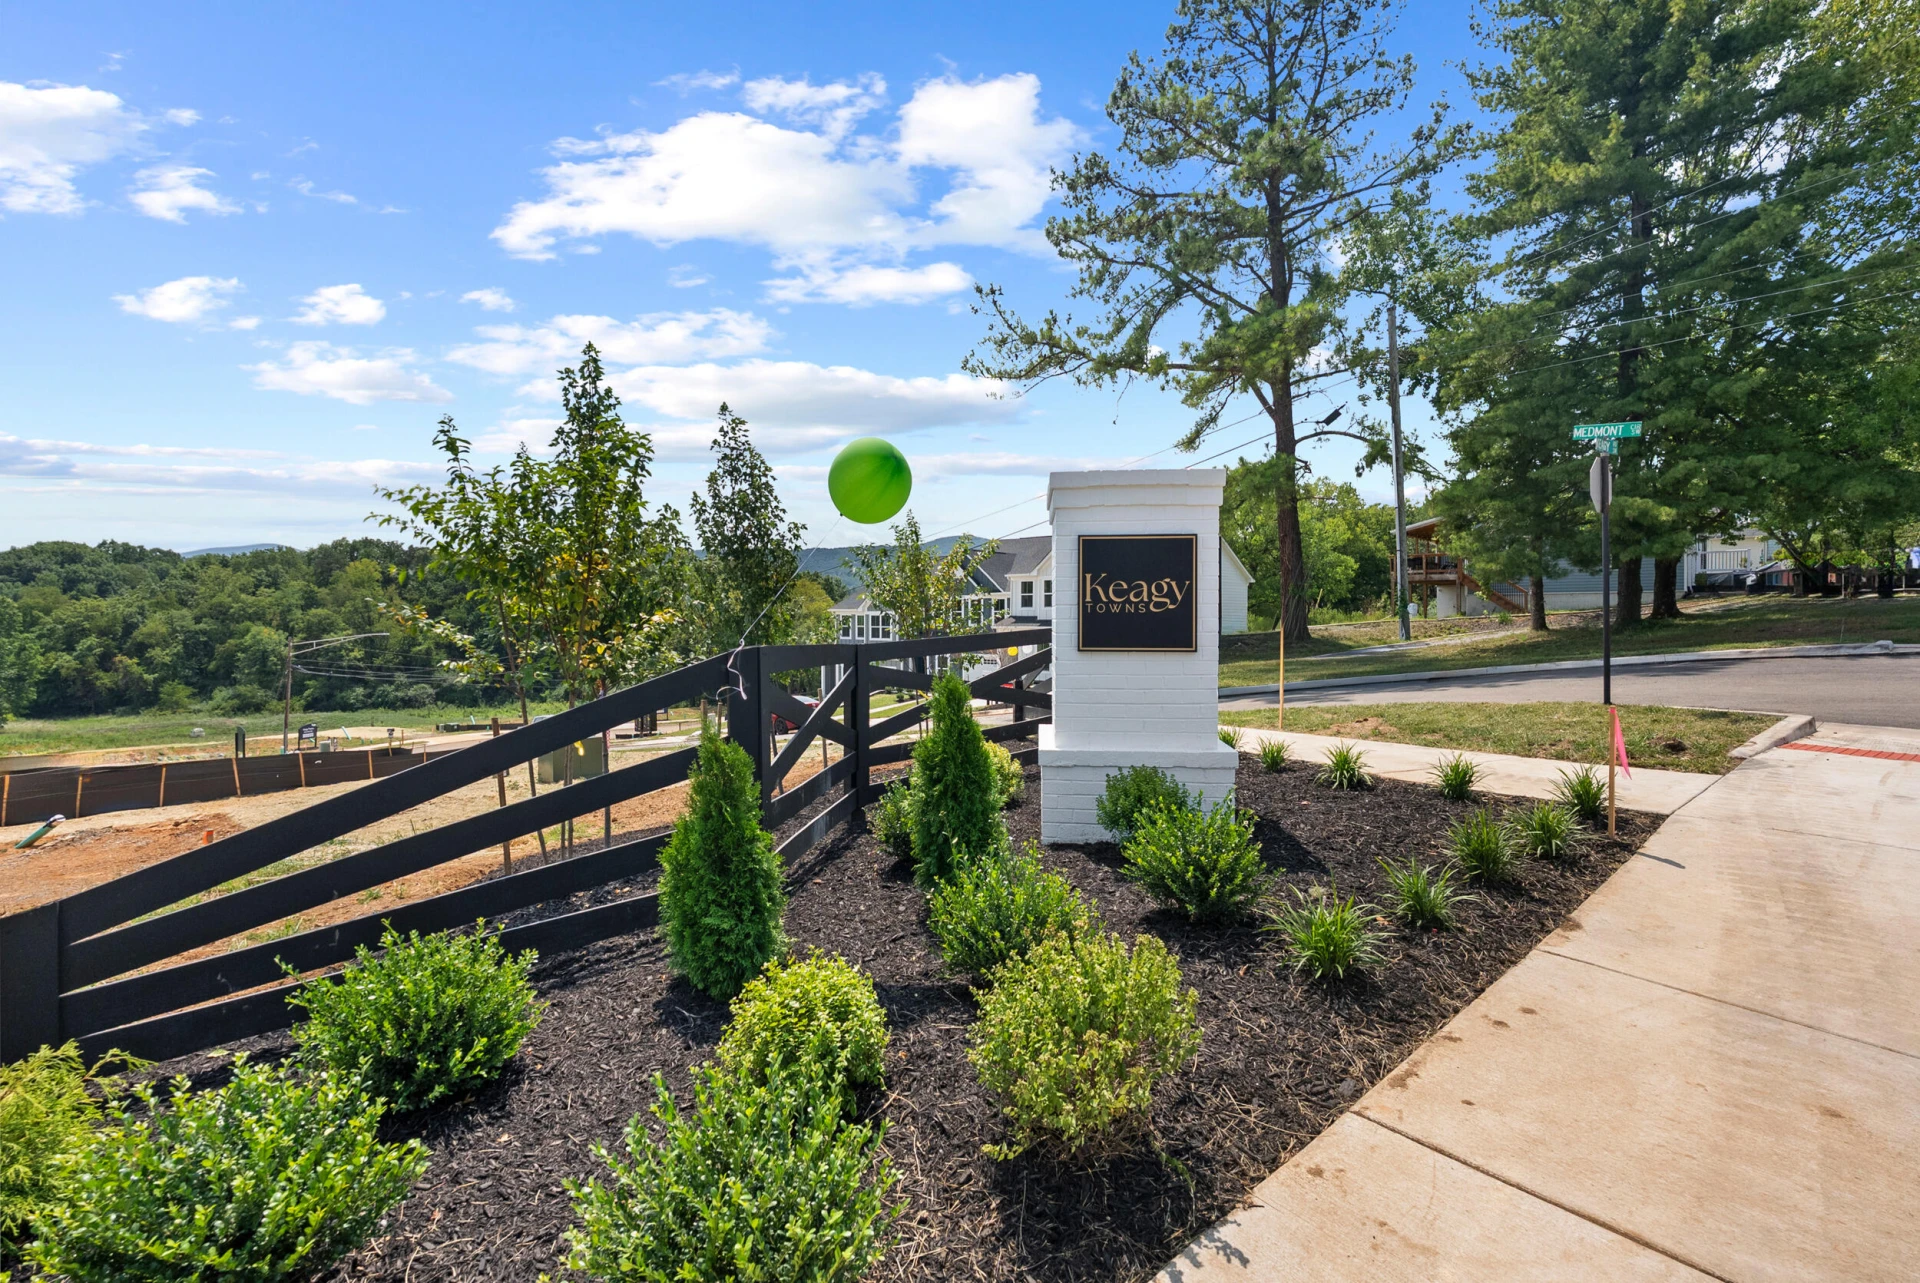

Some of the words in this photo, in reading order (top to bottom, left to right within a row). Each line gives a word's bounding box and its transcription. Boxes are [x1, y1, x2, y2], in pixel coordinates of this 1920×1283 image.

[1573, 425, 1625, 438] MEDMONT
[1084, 573, 1191, 612] Keagy
[1085, 603, 1146, 613] TOWNS
